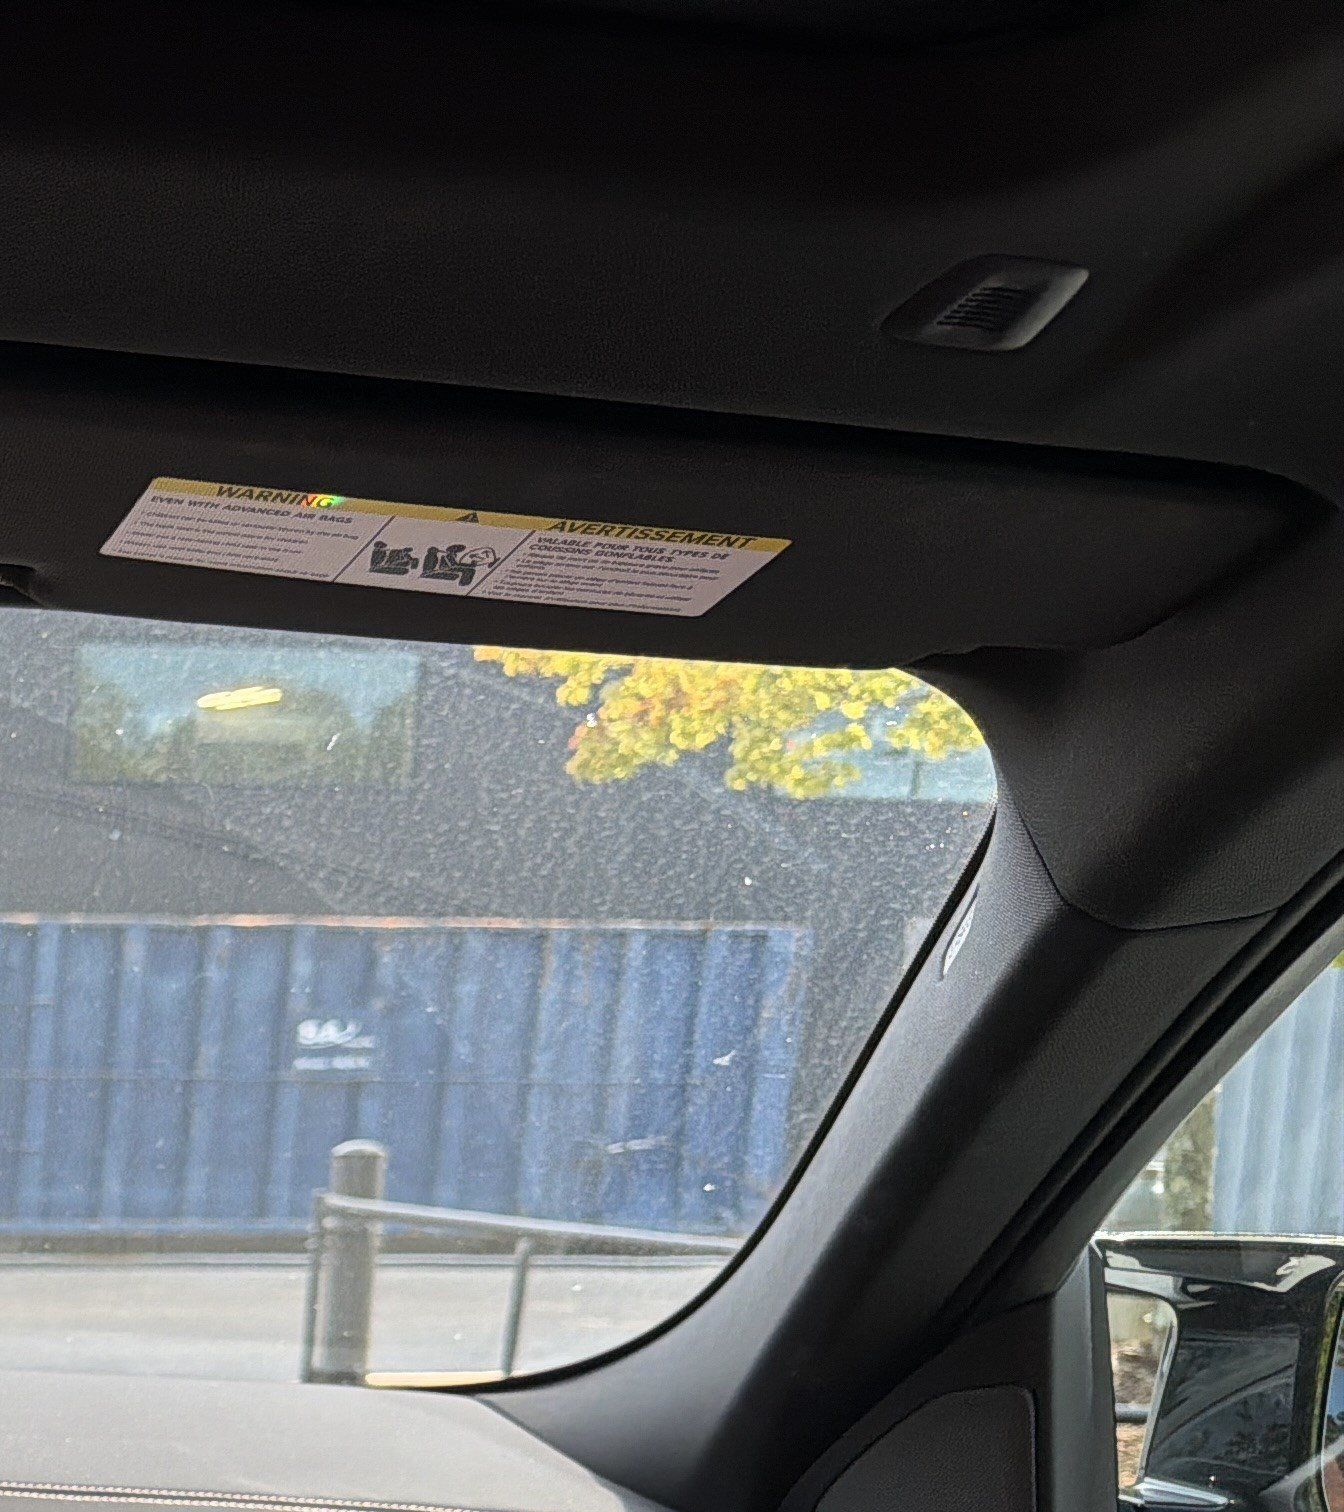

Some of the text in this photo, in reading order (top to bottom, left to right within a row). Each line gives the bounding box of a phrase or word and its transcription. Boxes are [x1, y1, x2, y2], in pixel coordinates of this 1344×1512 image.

[215, 485, 336, 508] WARNING
[150, 495, 354, 525] EVEN WITH ADVANCED AIR BAGS
[546, 519, 758, 549] AVERTISSEMENT
[536, 537, 591, 549] VALABLE
[635, 545, 668, 554] TOUS
[670, 548, 709, 558] TYPES
[710, 552, 731, 560] DE
